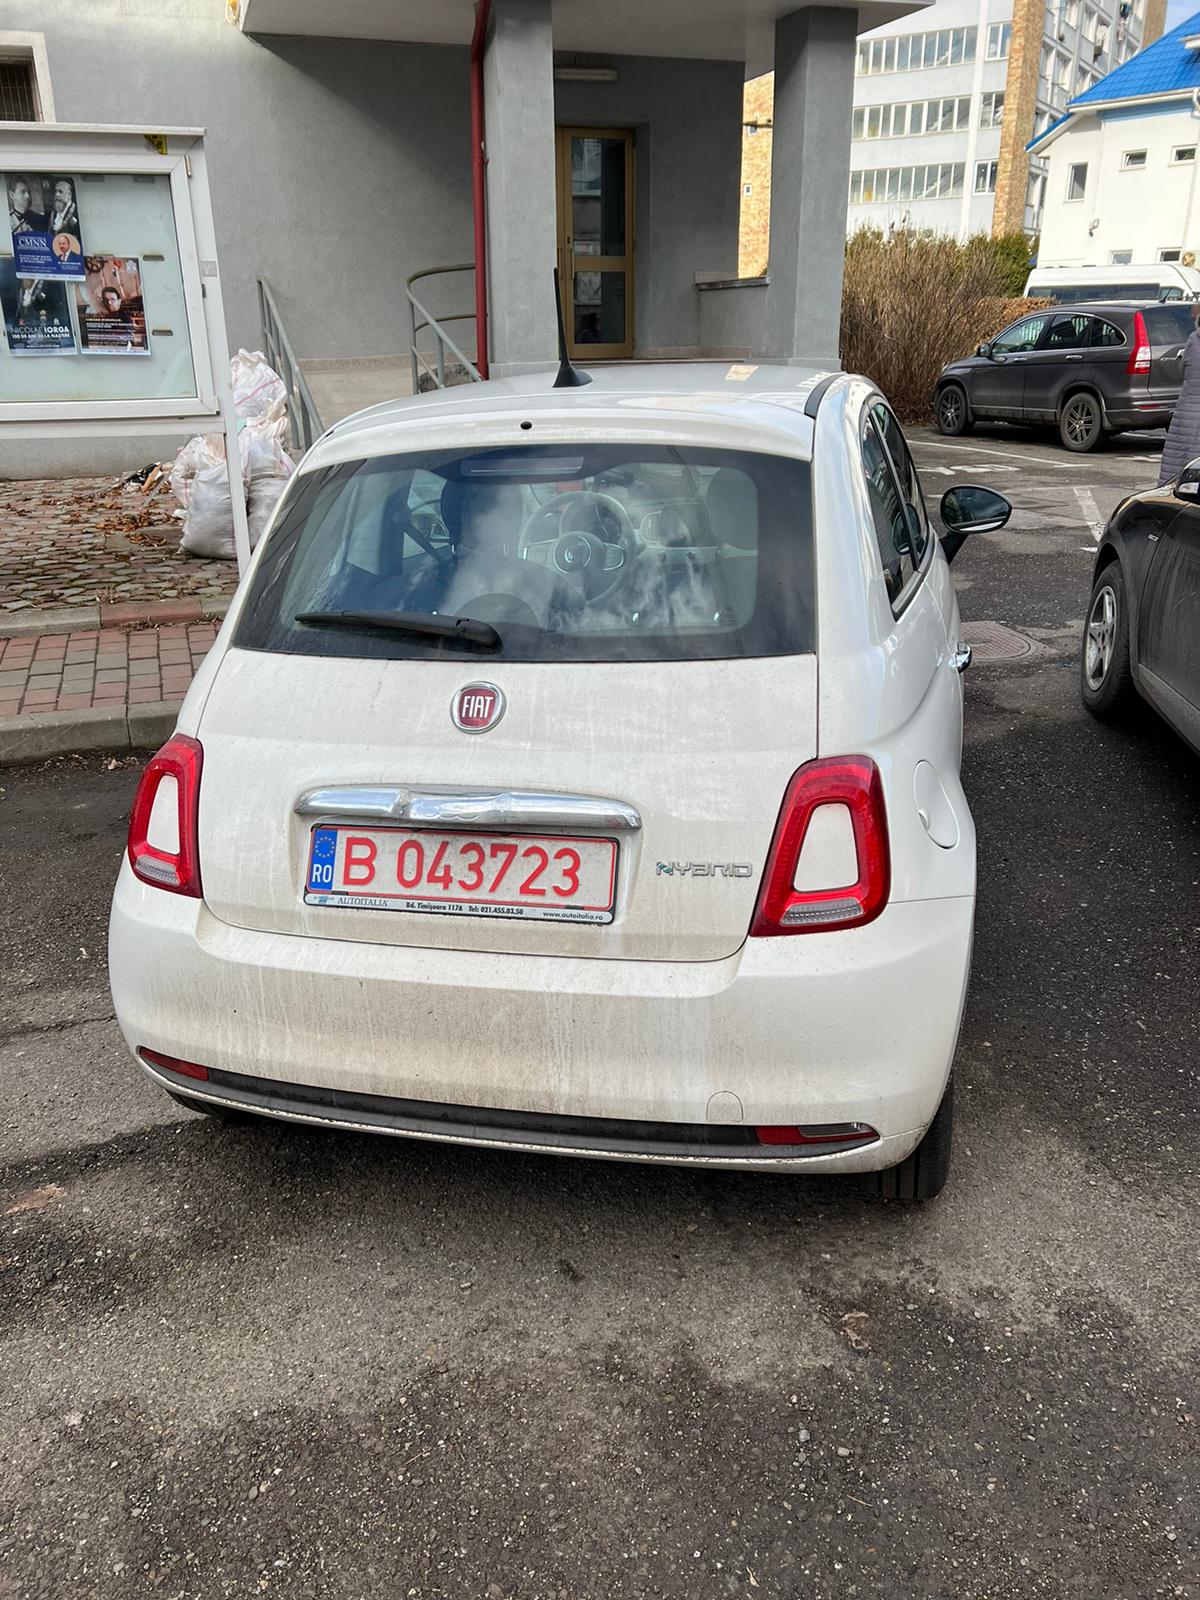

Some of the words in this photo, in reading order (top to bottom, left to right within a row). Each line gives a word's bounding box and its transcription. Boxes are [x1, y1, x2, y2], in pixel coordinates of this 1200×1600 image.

[18, 238, 47, 247] CMNN
[461, 695, 494, 718] FIAT
[311, 863, 332, 883] RO
[342, 836, 378, 886] B
[396, 838, 581, 897] 043723
[656, 861, 753, 878] HYBRID
[337, 896, 388, 907] AUTOITALIA
[448, 904, 463, 912] 117A
[480, 907, 524, 915] 021.455.03.50
[543, 911, 603, 921] www.autoitalia.ro
